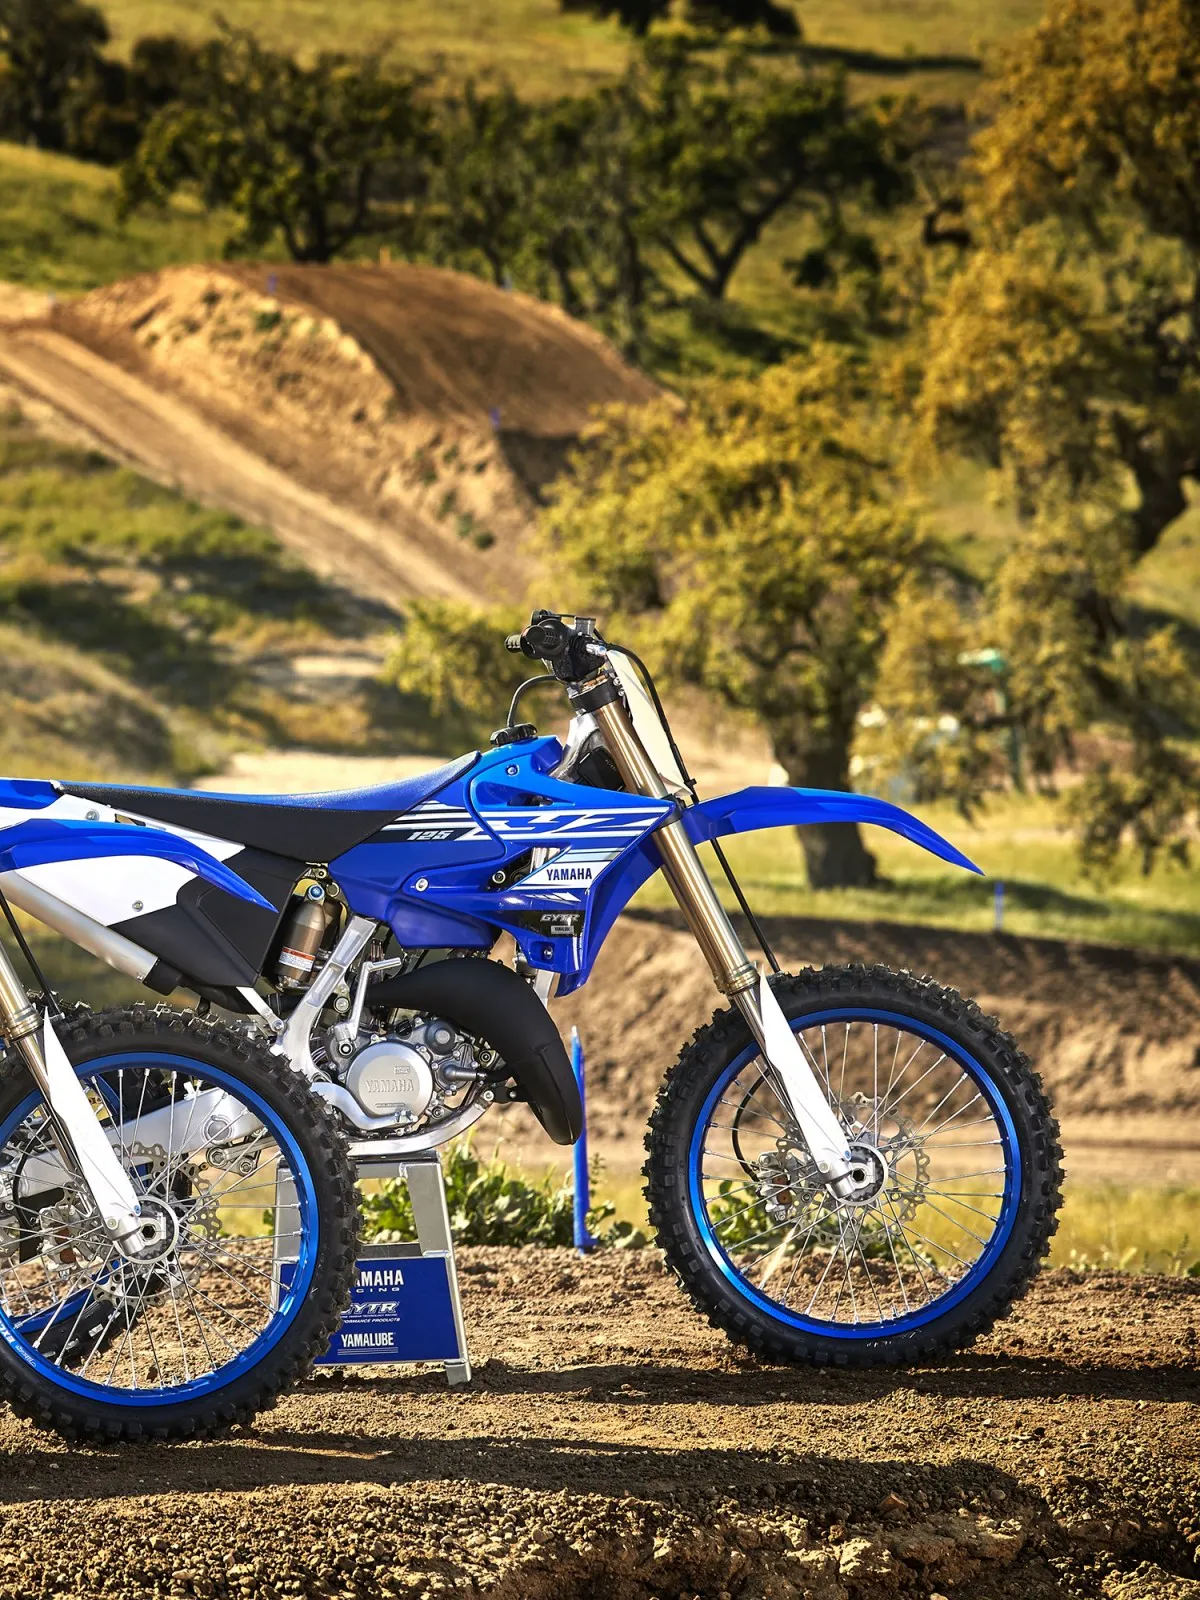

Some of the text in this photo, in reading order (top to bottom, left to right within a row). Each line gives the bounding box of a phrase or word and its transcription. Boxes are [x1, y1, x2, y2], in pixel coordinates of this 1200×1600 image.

[406, 829, 455, 841] 125
[546, 867, 593, 881] YAMAHA
[540, 913, 581, 922] GYTR
[364, 1078, 415, 1093] YAMAHA
[356, 1269, 404, 1287] MAHA
[340, 1331, 395, 1348] YAMALUBE
